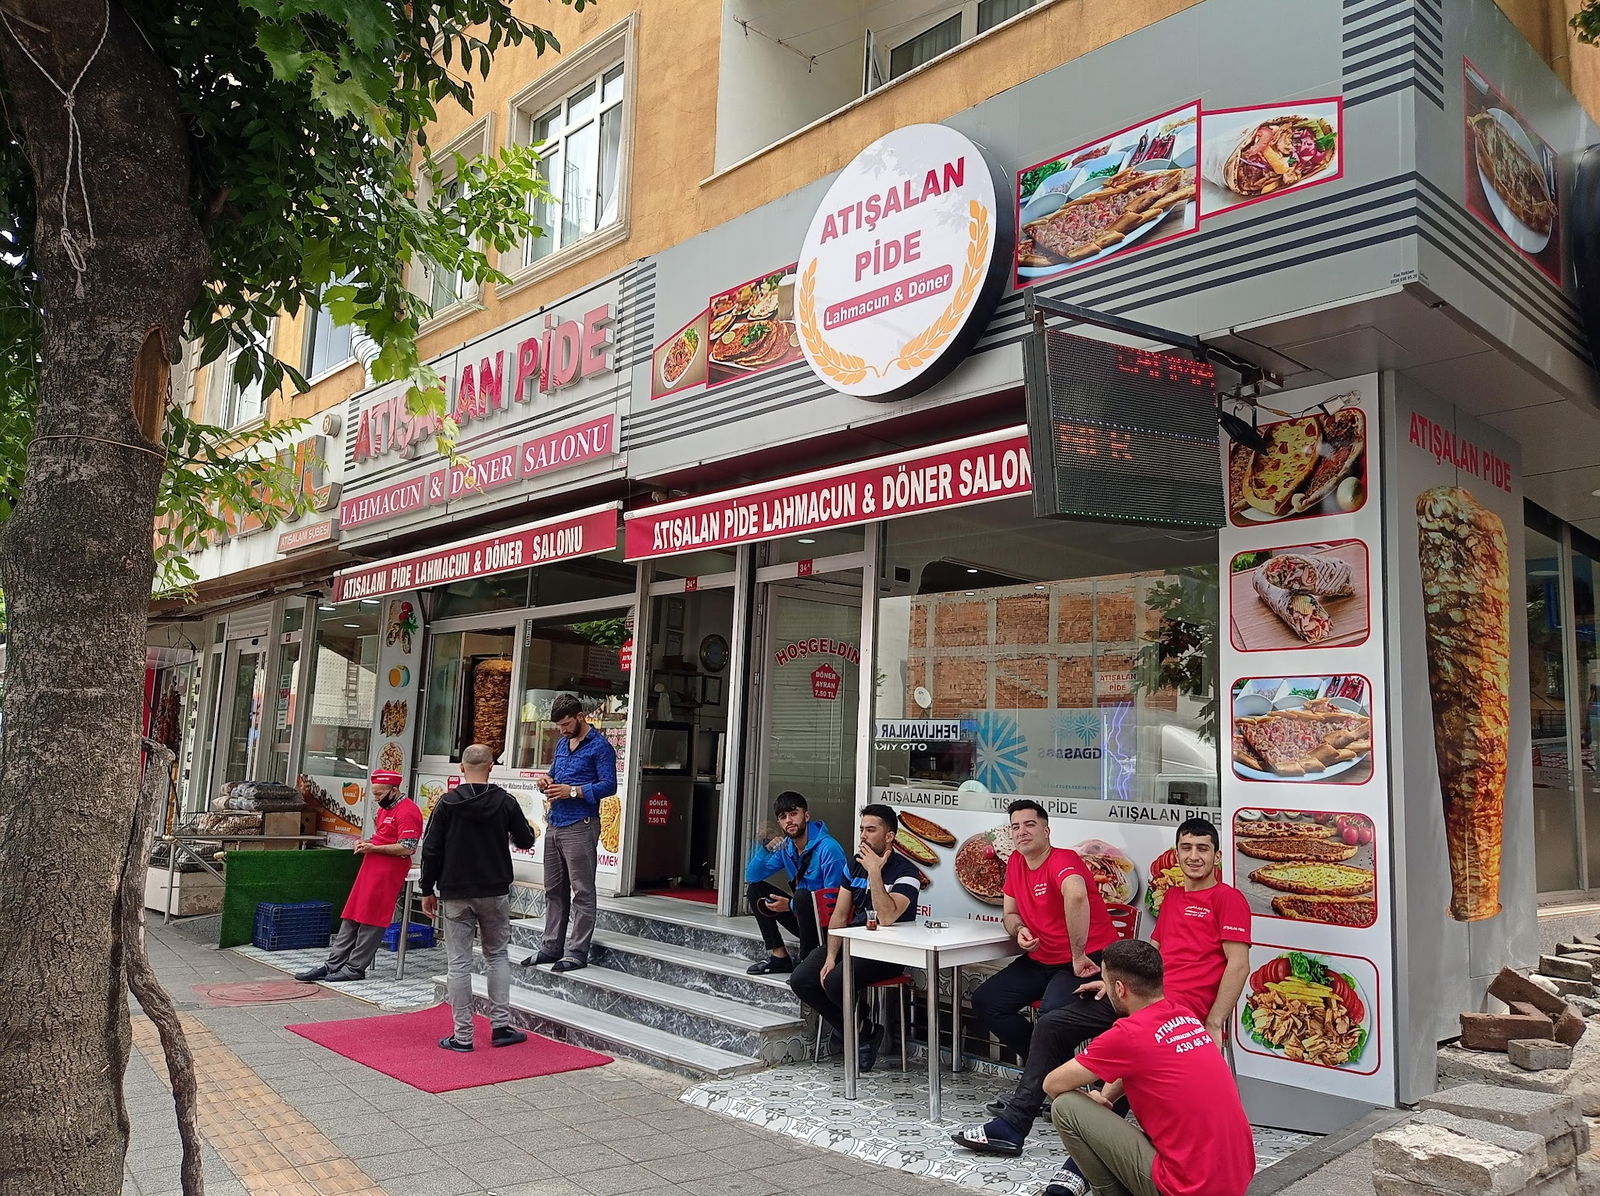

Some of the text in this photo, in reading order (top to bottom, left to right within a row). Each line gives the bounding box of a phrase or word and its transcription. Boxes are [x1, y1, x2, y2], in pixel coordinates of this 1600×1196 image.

[820, 156, 965, 245] ATIŞALAN
[855, 230, 921, 282] PİDE
[826, 273, 950, 327] Lahmacun & Döner
[352, 303, 612, 463] ATIŞAAN PİDE
[341, 482, 423, 526] LAHMACUN
[430, 476, 442, 499] &
[451, 453, 513, 495] DÖNER
[524, 423, 609, 473] SALONU
[1409, 411, 1512, 494] ATIŞALAN PİDE
[652, 510, 720, 551] ATIŞALAN
[724, 500, 759, 539] PİDE
[762, 482, 856, 533] LAHMACUN
[862, 483, 876, 513] &
[882, 465, 953, 511] DÖNER
[391, 562, 413, 590] PİDE
[415, 551, 470, 585] LAHMACUN
[474, 550, 482, 573] &
[485, 540, 523, 571] DÖNER
[532, 525, 583, 562] SALONU
[815, 671, 836, 680] DÖNER
[881, 790, 959, 806] ATIŞALAN PİDE
[1048, 798, 1078, 814] PİDE
[1109, 805, 1180, 822] ATIŞALAN
[1154, 1016, 1187, 1044] ATIŞALAN
[1175, 1041, 1193, 1053] 430
